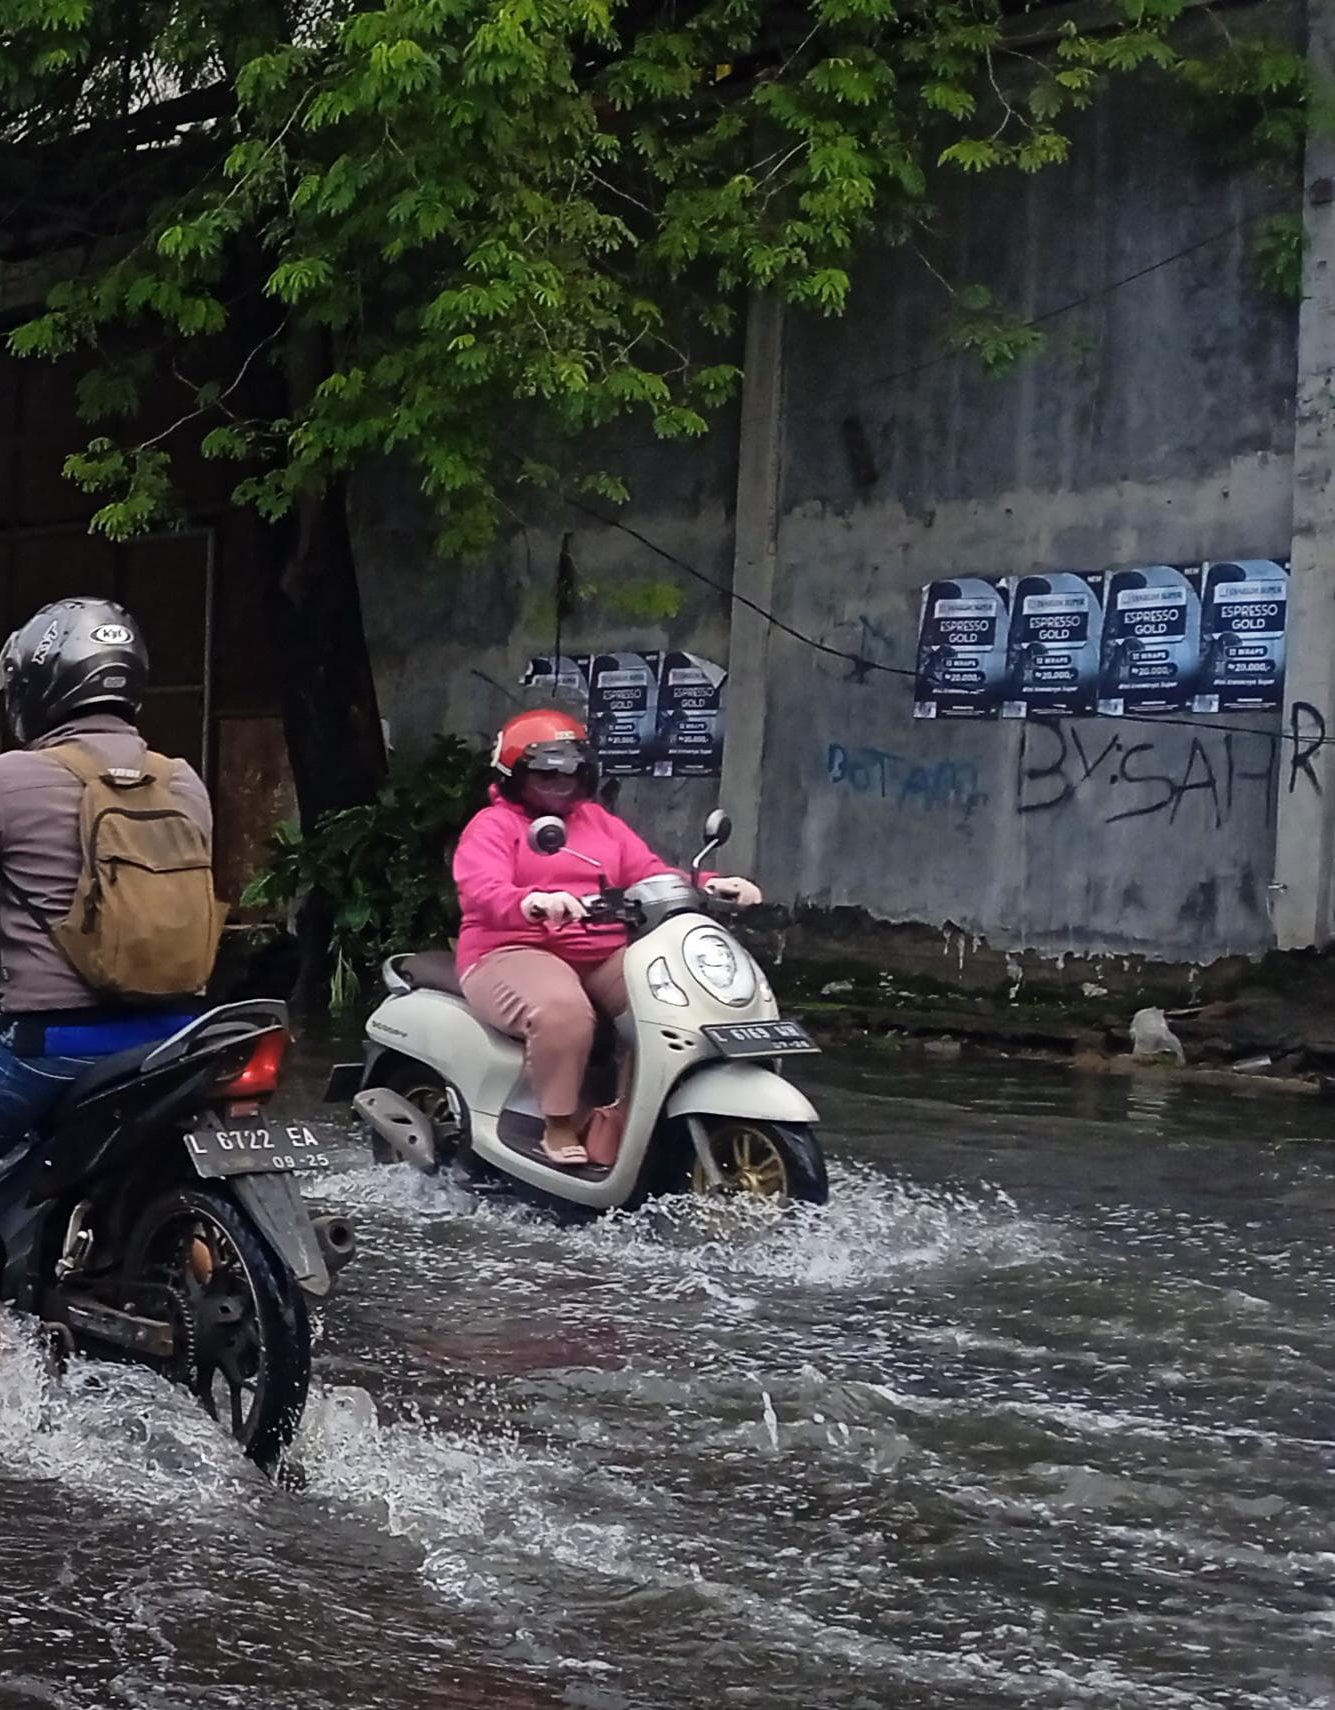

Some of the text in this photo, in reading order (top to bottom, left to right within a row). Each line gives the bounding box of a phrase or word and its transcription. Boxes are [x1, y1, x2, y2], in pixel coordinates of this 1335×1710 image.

[1124, 609, 1179, 624] ESPRESSO
[1221, 604, 1278, 618] ESPRESSO
[940, 620, 989, 632] ESPRESSO
[1030, 616, 1081, 629] ESPRESSO
[1232, 619, 1265, 630] GOLD
[1039, 630, 1069, 639] GOLD
[1135, 624, 1167, 635] GOLD
[949, 633, 978, 643] GOLD
[603, 689, 641, 699] ESPRESSO
[674, 688, 714, 698] ESPRESSO
[610, 701, 633, 710] GOLD
[681, 699, 705, 709] GOLD
[710, 1030, 728, 1042] L
[189, 1127, 319, 1154] L 6722 EA
